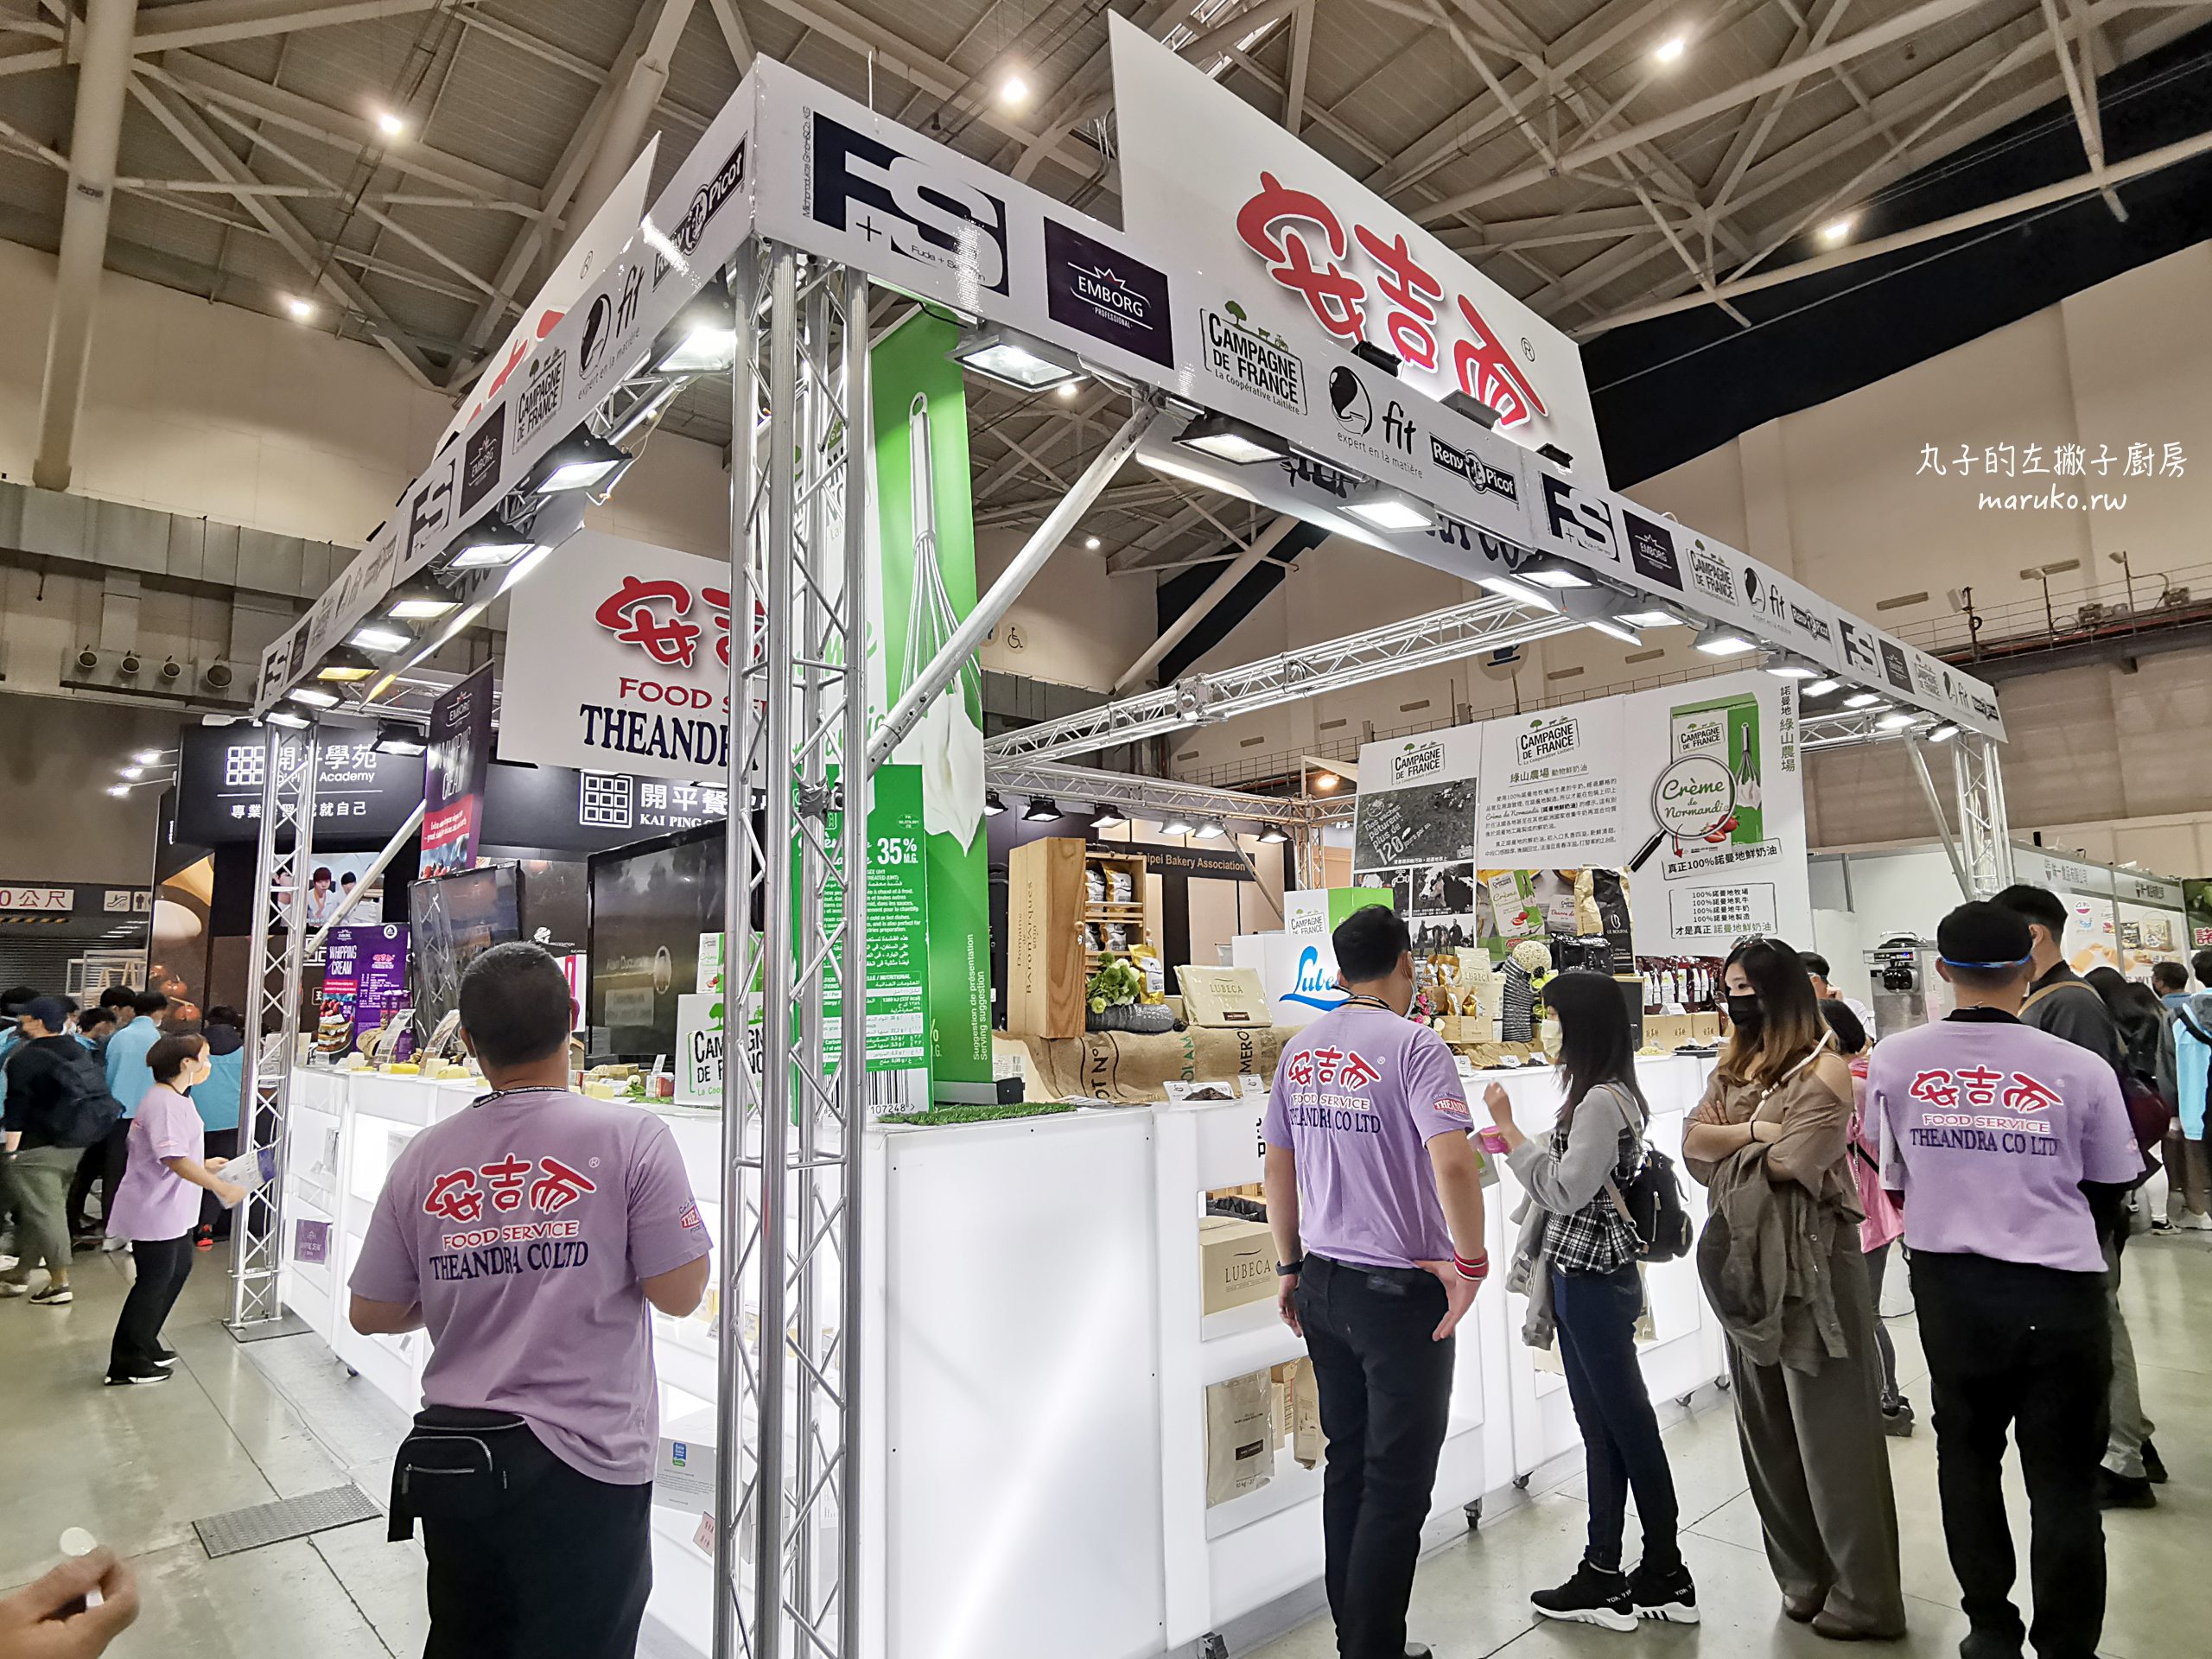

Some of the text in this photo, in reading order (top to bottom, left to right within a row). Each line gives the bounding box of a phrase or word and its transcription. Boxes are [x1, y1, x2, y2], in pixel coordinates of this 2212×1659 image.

[709, 153, 742, 208] Picot
[616, 265, 645, 338] fit
[1078, 275, 1144, 319] EMBORG
[1095, 307, 1130, 327] PROFESSIONAL
[1209, 313, 1297, 383] CAMPAGNE
[1213, 349, 1298, 404] DE FRANCE
[518, 361, 562, 423] CAMPAGNE
[1215, 370, 1300, 416] La Coopérative Laitière
[527, 388, 560, 433] FRANCE
[1382, 401, 1416, 454] fit
[1337, 431, 1423, 480] expert en la matière
[1433, 442, 1516, 496] Reny Picot
[1640, 542, 1668, 562] EMBORG
[1690, 550, 1732, 586] CAMPAGNE
[1707, 576, 1735, 600] FRANCE
[1770, 584, 1785, 620] fit
[619, 677, 712, 709] FOOD
[580, 703, 758, 771] THEAND
[1521, 723, 1573, 750] CAMPAGNE
[1522, 735, 1573, 760] DE FRANCE
[1681, 726, 1720, 744] CAMPAGNE
[1693, 734, 1720, 748] FRANCE
[1395, 748, 1440, 771] CAMPAGNE
[1395, 771, 1403, 779] DE
[1408, 759, 1440, 777] FRANCE
[319, 772, 375, 783] Academy
[1662, 778, 1726, 800] Crème
[1688, 798, 1698, 806] de
[640, 814, 702, 829] KAI PING
[1166, 855, 1196, 869] Bakery
[1198, 857, 1246, 871] Association
[1376, 836, 1404, 866] 120
[1291, 916, 1323, 931] CAMPAGNE
[1675, 925, 1711, 935] 才是真正
[329, 945, 357, 959] WHIPPING
[331, 961, 352, 975] CREAM
[977, 971, 988, 1022] suggestion
[1210, 983, 1243, 994] LUBECA
[970, 1008, 980, 1060] Suggestion
[697, 1067, 710, 1083] DE
[871, 1103, 906, 1114] 107248
[1293, 1093, 1370, 1111] FOOD SERVICE
[1334, 1113, 1353, 1132] CO
[1356, 1114, 1381, 1134] LTD
[1923, 1114, 2050, 1135] FOOD SERVICE
[1910, 1128, 2061, 1156] THEANDRA CO LTD
[442, 1220, 580, 1250] FOOD SERVICE
[429, 1245, 523, 1281] THEANDRA
[1225, 1258, 1271, 1284] LUBECA
